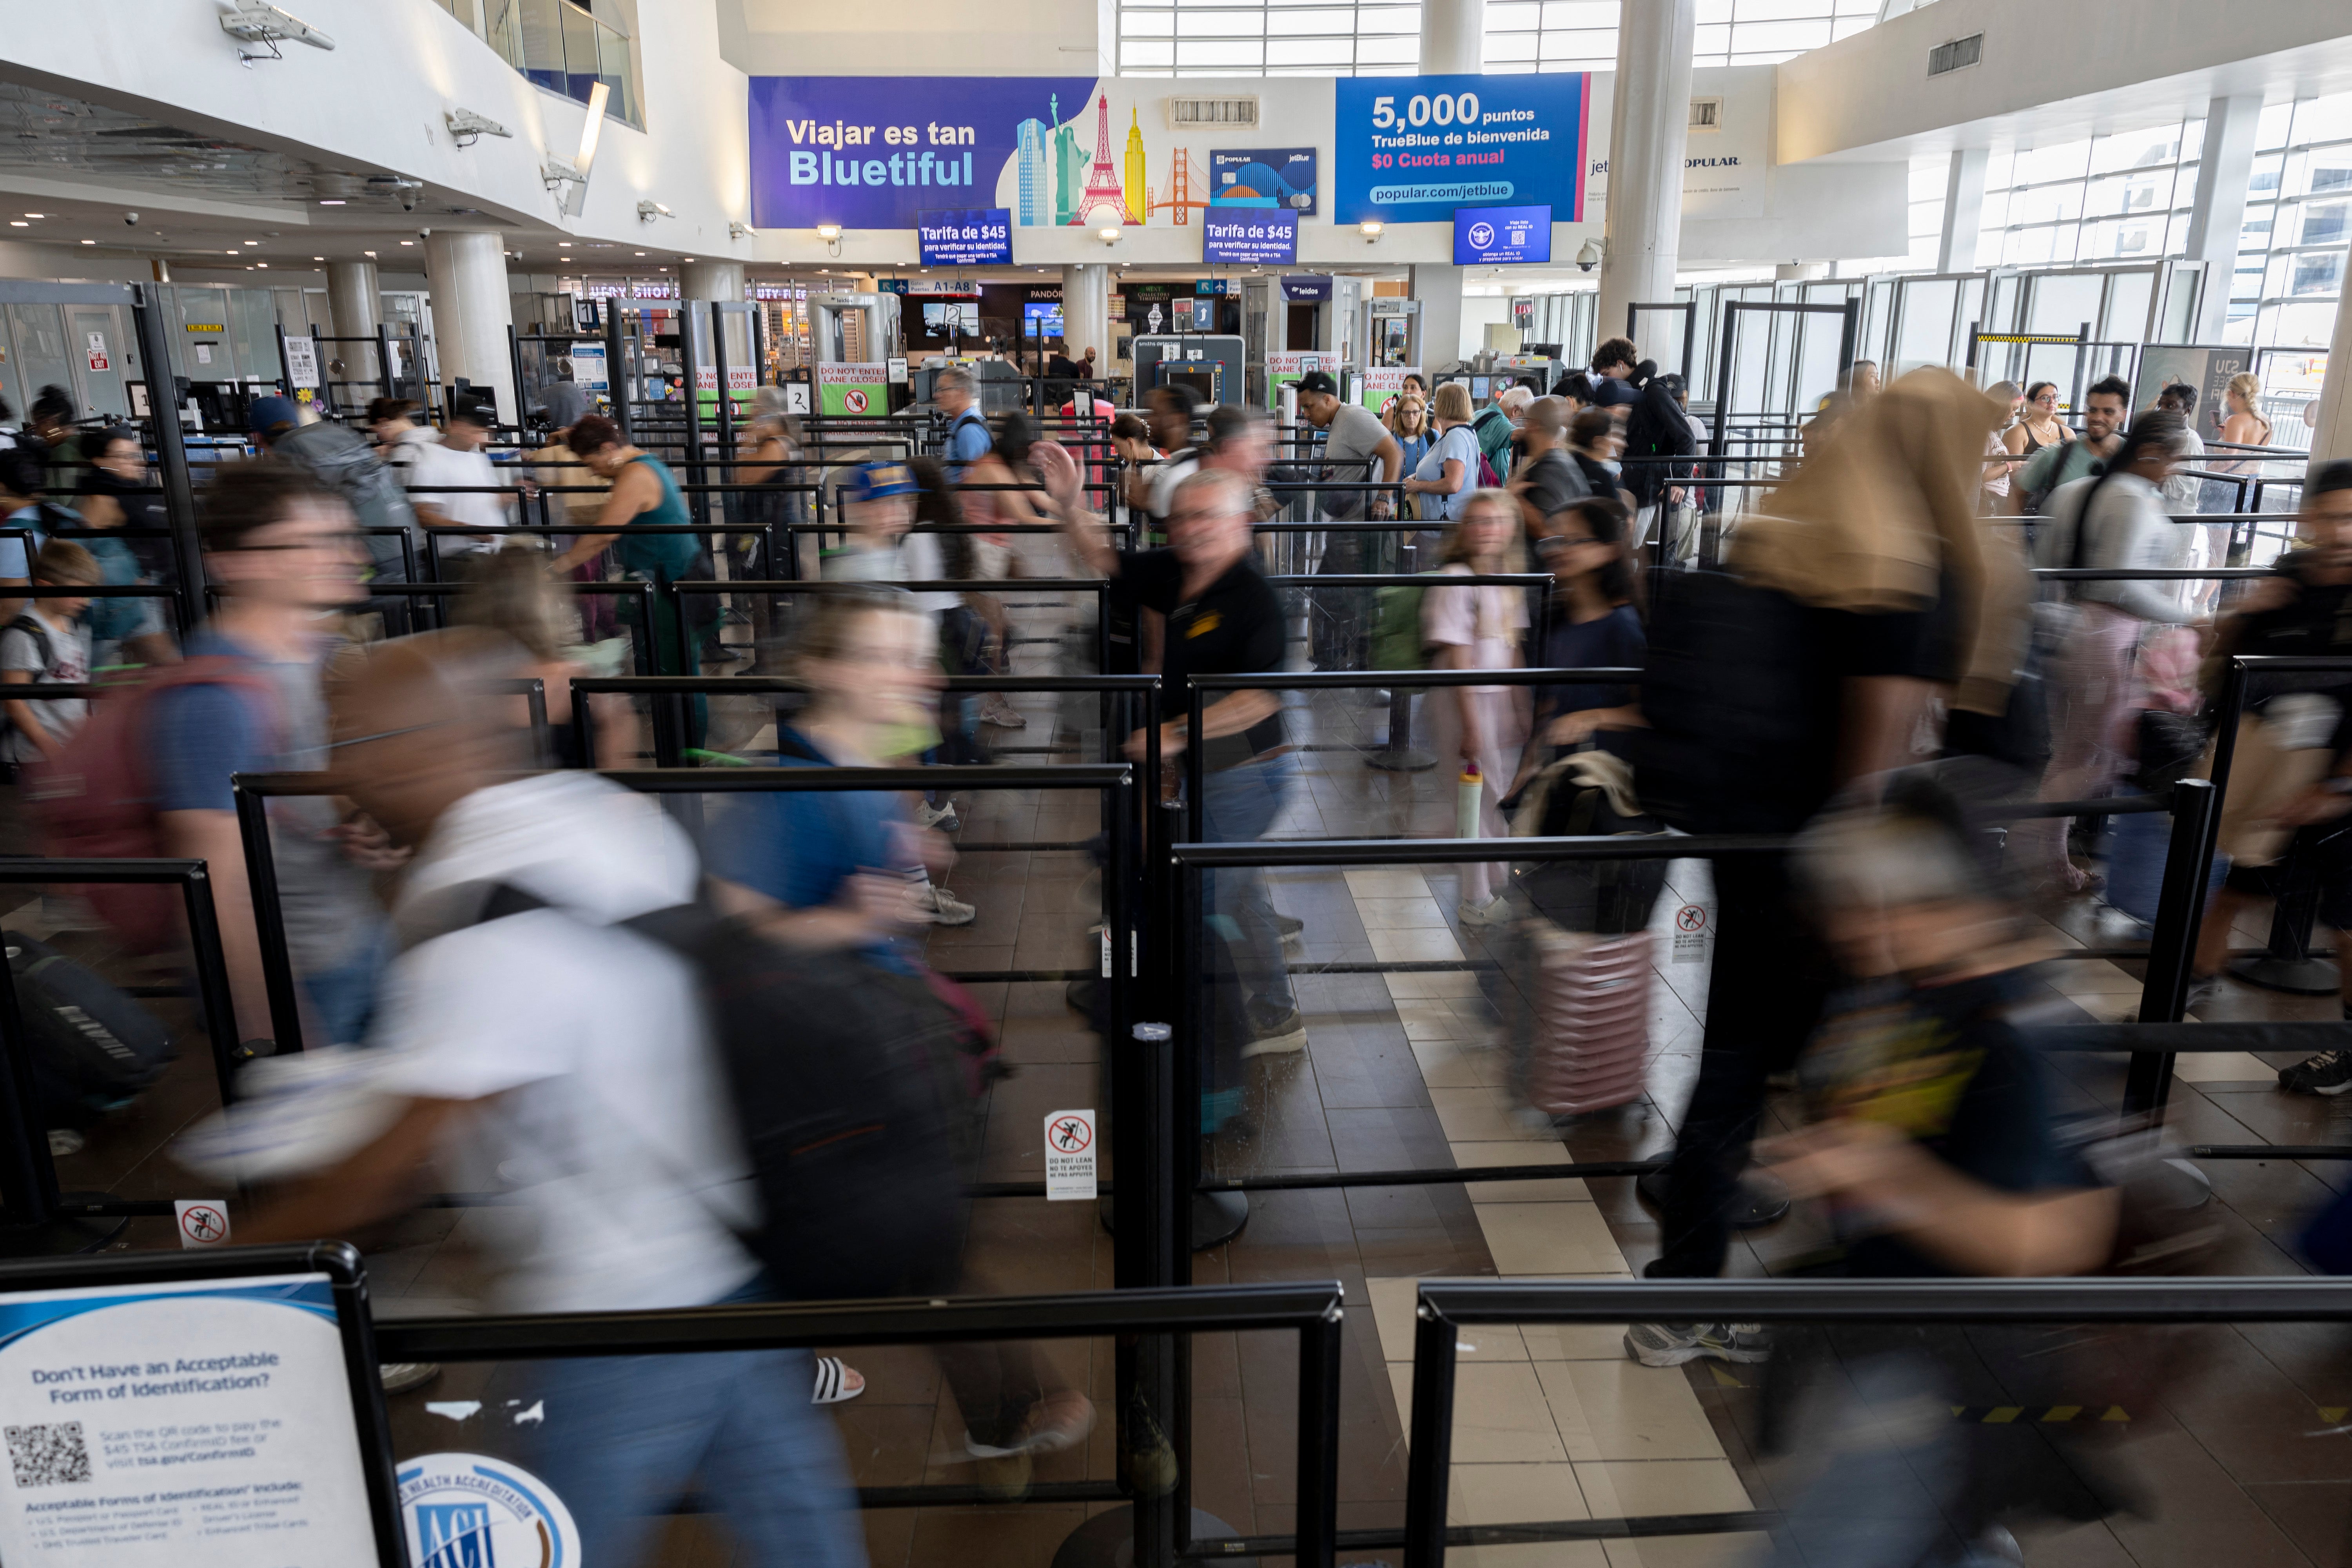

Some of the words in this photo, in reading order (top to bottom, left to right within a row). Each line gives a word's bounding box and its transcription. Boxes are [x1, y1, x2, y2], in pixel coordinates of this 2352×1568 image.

[1372, 93, 1479, 134] 5,000
[1483, 109, 1535, 125] puntos
[786, 120, 875, 151] Viajar
[884, 126, 918, 145] es
[928, 121, 975, 145] tan
[1372, 134, 1439, 148] TrueBlue
[1444, 132, 1462, 145] de
[1467, 128, 1550, 143] bienvenida
[1289, 154, 1309, 163] jetBlue
[1372, 153, 1392, 170] $0
[1398, 152, 1450, 167] Cuota
[1456, 149, 1504, 165] anual
[1685, 157, 1738, 168] OPULAR
[790, 151, 972, 186] Bluetiful
[1376, 184, 1508, 201] popular.com/jetblue
[921, 226, 959, 240] Tarifa
[962, 226, 978, 240] de
[981, 225, 1006, 240] $45
[1207, 224, 1244, 238] Tarifa
[1248, 225, 1264, 238] de
[1267, 225, 1292, 240] $45
[940, 243, 966, 251] verificar
[1224, 241, 1250, 249] verificar
[1260, 242, 1291, 250] identidad.
[750, 288, 779, 299] UTY
[934, 281, 970, 291] A1-A8
[1031, 289, 1063, 298] PANDOR
[582, 303, 589, 321] 1
[947, 307, 958, 323] 2
[89, 352, 100, 360] NOT
[100, 352, 107, 360] AN
[94, 360, 105, 368] EXIT
[795, 392, 802, 404] 2
[32, 1367, 84, 1384] Don't
[89, 1364, 140, 1379] Have
[146, 1362, 169, 1375] an
[176, 1352, 279, 1373] Acceptable
[49, 1388, 103, 1404] Form
[107, 1383, 125, 1398] of
[132, 1372, 270, 1397] Identification?
[134, 1429, 155, 1439] the
[159, 1426, 178, 1437] QR
[181, 1424, 211, 1436] code
[214, 1422, 229, 1432] to
[232, 1421, 256, 1433] pay
[260, 1418, 281, 1429] the
[103, 1443, 129, 1455] $45
[134, 1441, 156, 1452] TSA
[230, 1435, 250, 1444] fee
[254, 1434, 267, 1443] or
[26, 1498, 96, 1513] Acceptable
[99, 1496, 140, 1506] Forms
[143, 1493, 156, 1503] of
